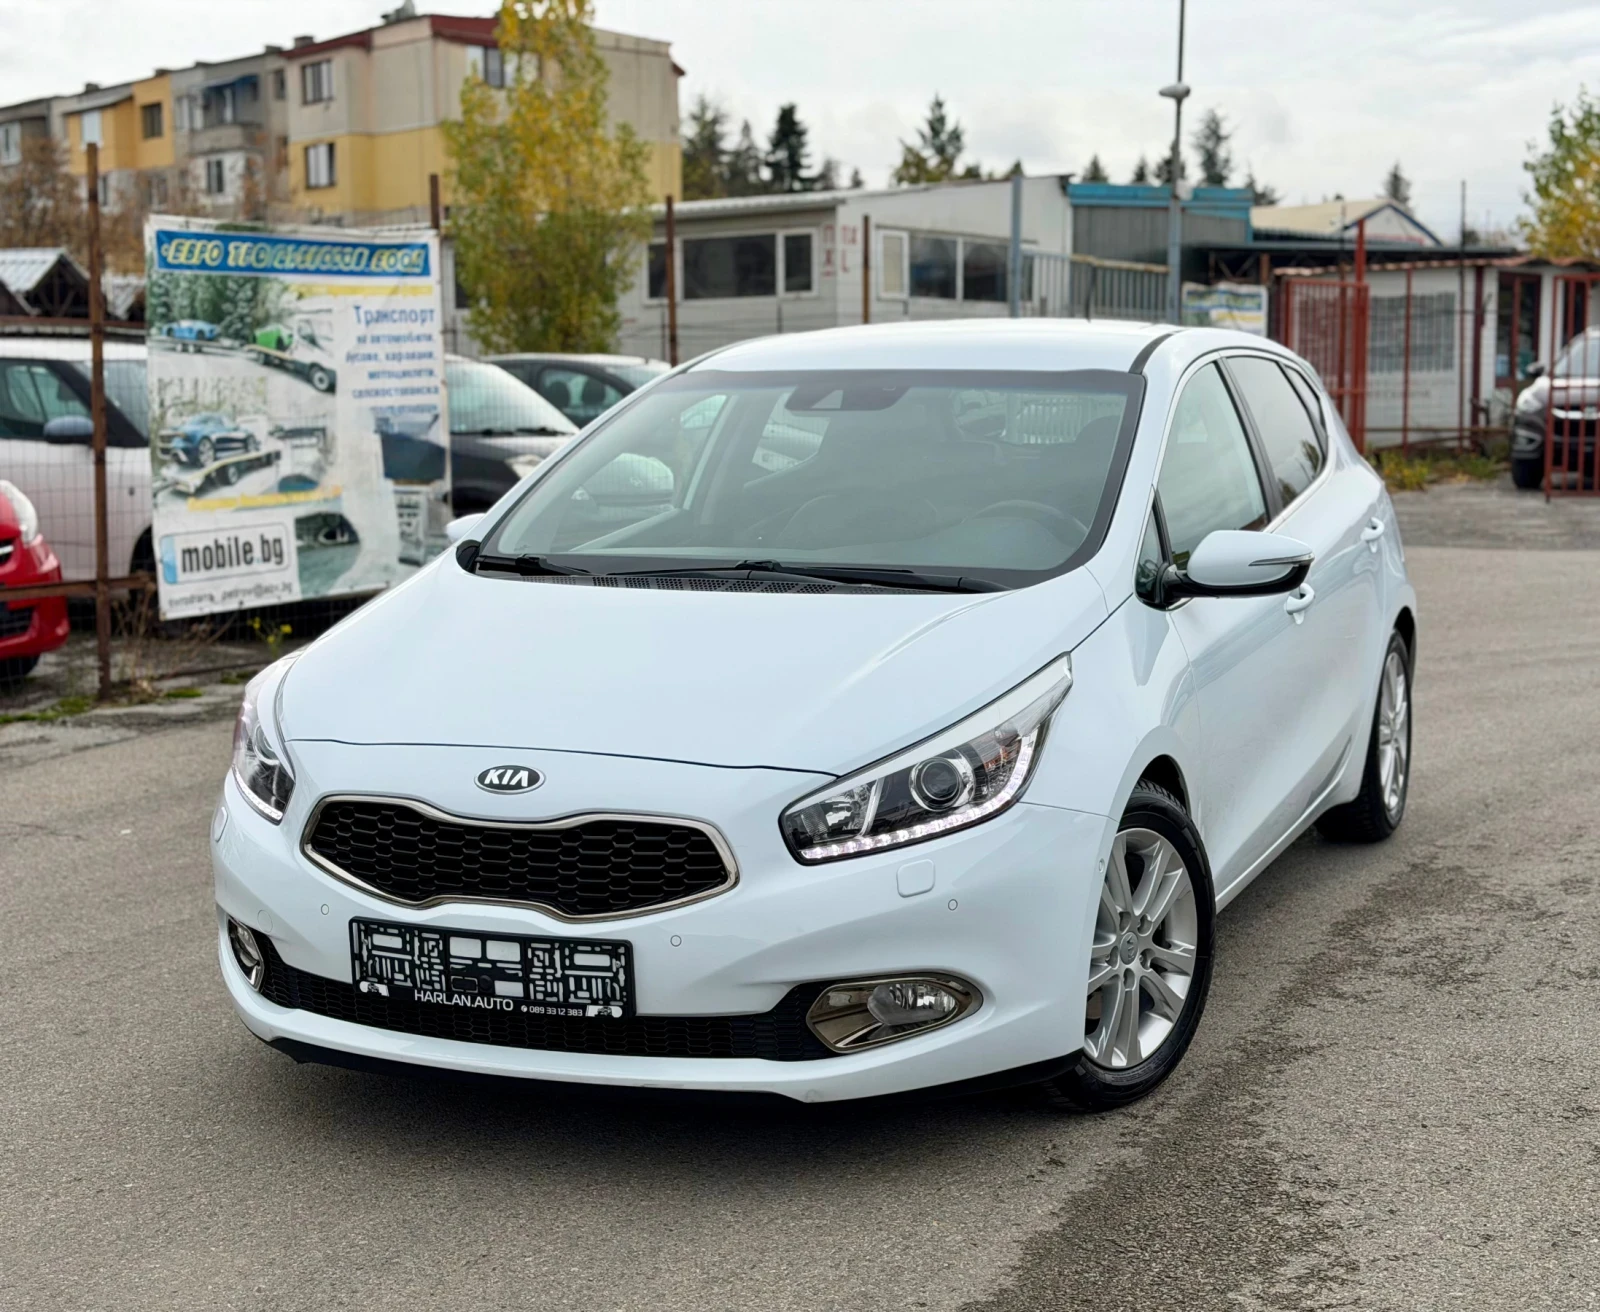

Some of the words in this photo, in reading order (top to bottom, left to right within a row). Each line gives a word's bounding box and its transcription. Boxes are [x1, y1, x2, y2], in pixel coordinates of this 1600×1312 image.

[353, 305, 435, 327] Транспорт
[182, 534, 284, 573] mobile.bg
[484, 769, 529, 787] KIA
[414, 989, 514, 1011] HARLAN.AUTO
[529, 1006, 545, 1014] 089
[567, 1008, 583, 1017] 383
